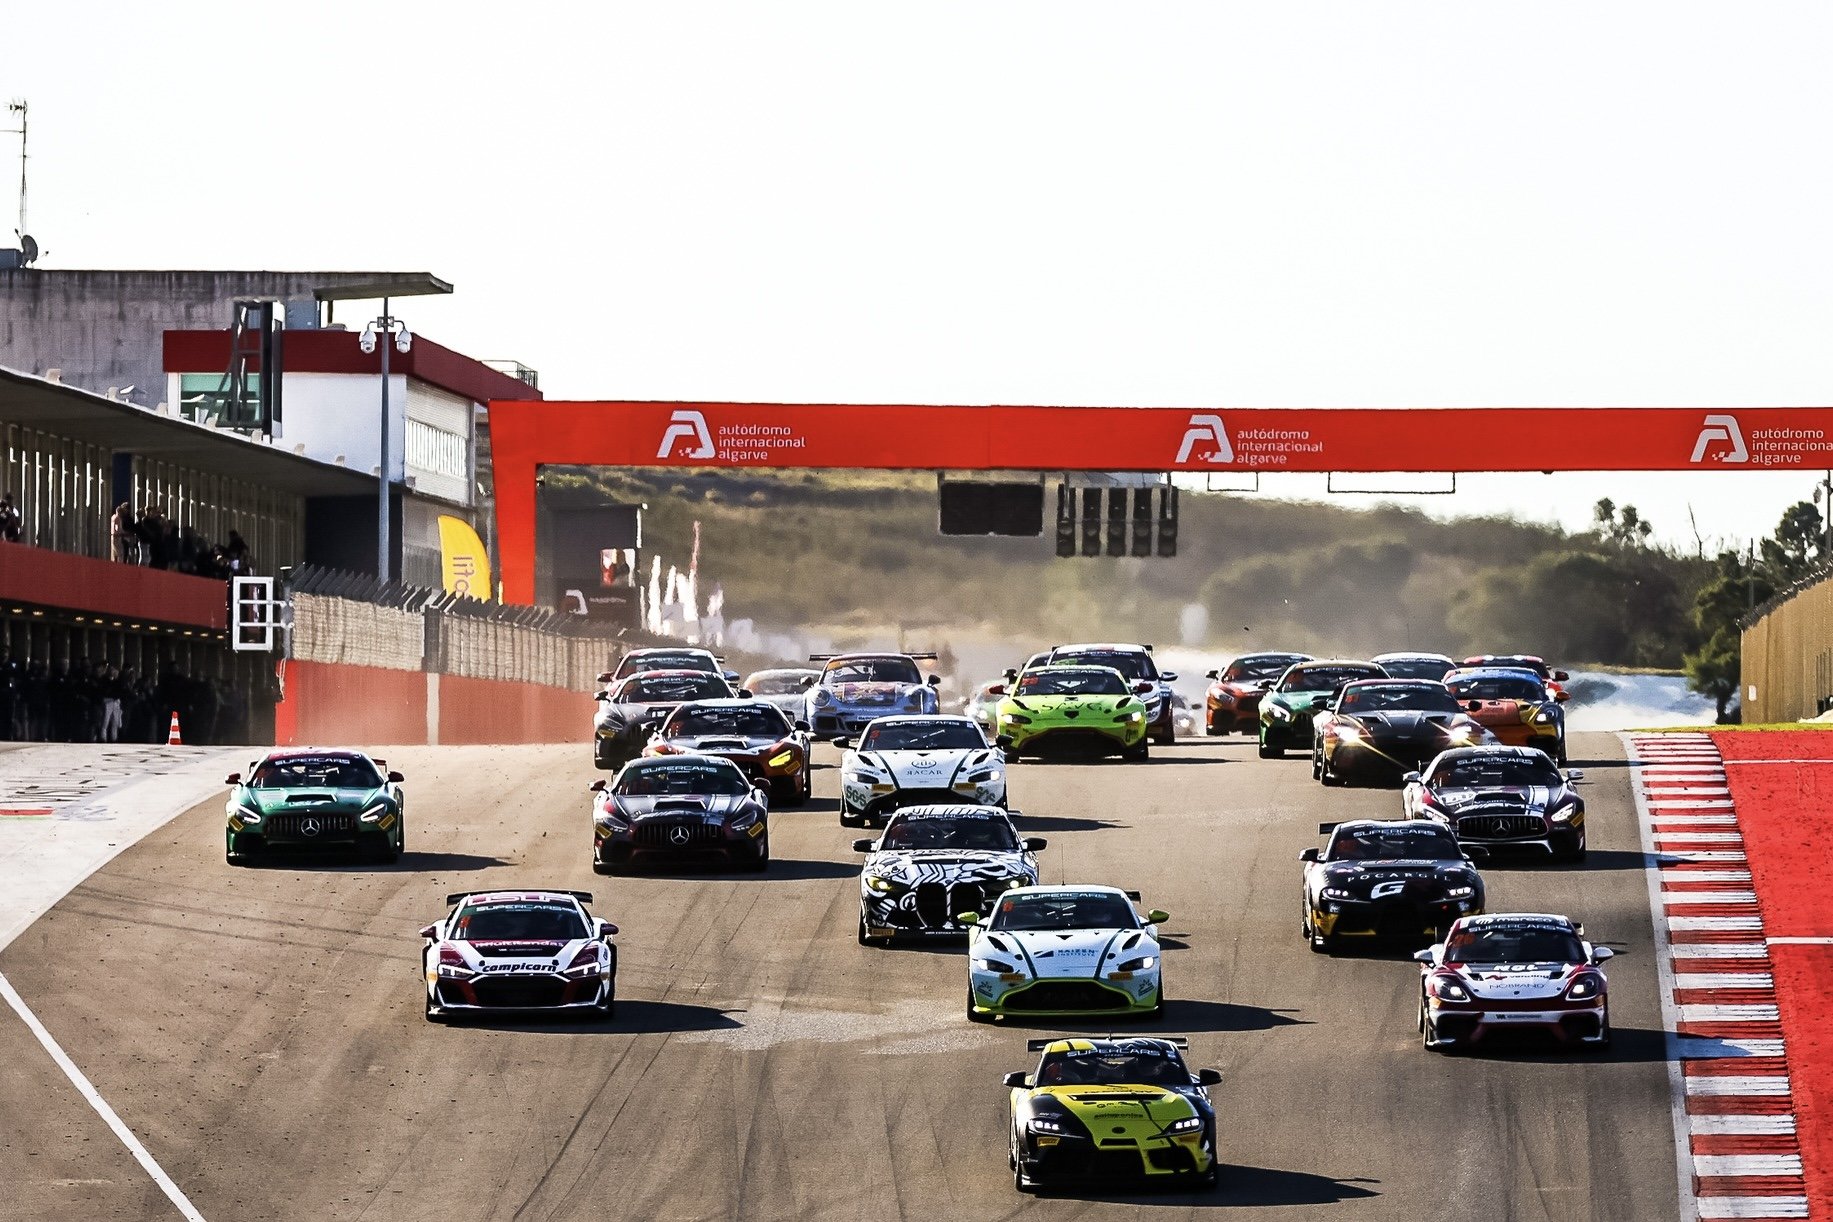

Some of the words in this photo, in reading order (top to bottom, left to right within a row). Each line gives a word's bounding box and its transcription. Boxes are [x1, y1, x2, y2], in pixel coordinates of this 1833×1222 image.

[718, 424, 791, 435] autódromo
[1237, 428, 1310, 440] autódromo
[1752, 427, 1824, 439] autódromo
[719, 436, 806, 448] internacional
[1237, 440, 1323, 452] internacional
[1752, 440, 1833, 451] internaciona
[718, 448, 768, 462] algarve
[1236, 452, 1287, 466] algarve
[1751, 452, 1801, 466] algarve
[274, 757, 351, 766] SUPERCARS
[1456, 757, 1533, 766] SUPERCARS
[640, 765, 718, 775] SUPERCARS
[1353, 828, 1437, 837] SUPERCARS
[1021, 892, 1108, 901] SUPERCARS
[476, 904, 562, 912] SUPERCARS
[1468, 923, 1556, 933] SUPERCARS
[1066, 1048, 1161, 1058] SUPERCARS
